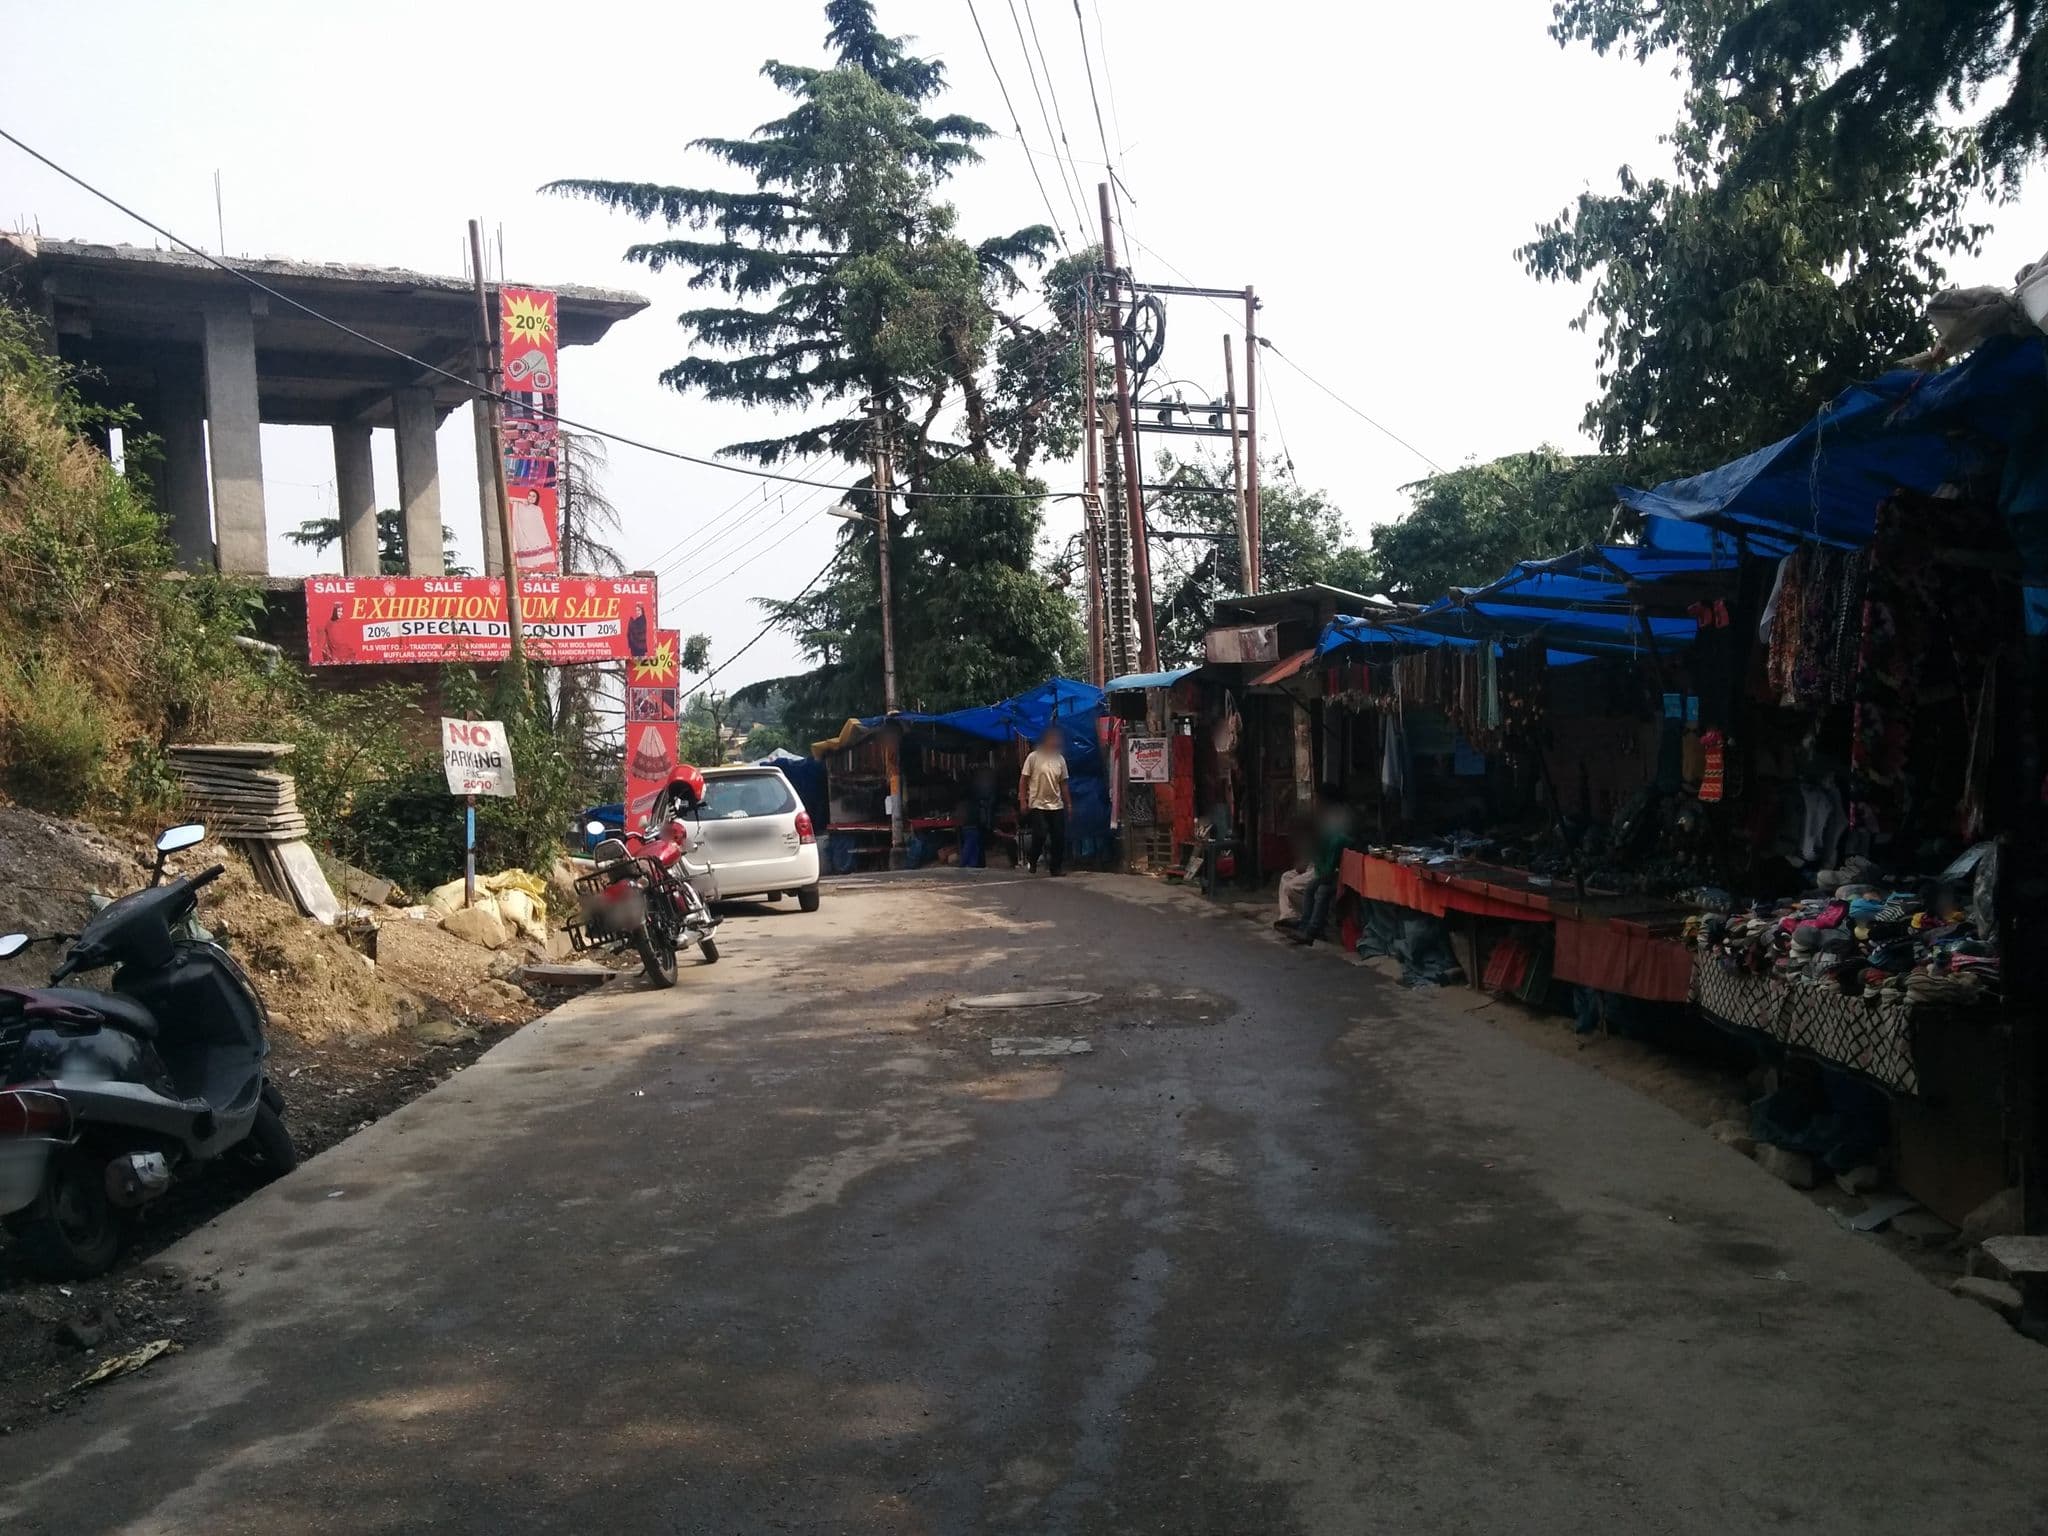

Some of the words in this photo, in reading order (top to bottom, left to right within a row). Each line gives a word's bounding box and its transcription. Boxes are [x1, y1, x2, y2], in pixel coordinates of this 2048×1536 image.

[515, 314, 550, 332] 20%
[314, 582, 356, 593] SALE
[424, 581, 463, 593] SALE
[523, 582, 561, 593] SALE
[612, 583, 649, 594] SALE
[350, 596, 500, 620] EXHIBITION
[506, 597, 561, 619] UM
[564, 597, 621, 619] SALE
[367, 626, 391, 638] 20%
[401, 621, 482, 635] SPECIAL
[488, 623, 587, 637] DICOUNT
[597, 623, 618, 635] 20%
[449, 723, 491, 747] NO
[445, 750, 502, 768] PARKING
